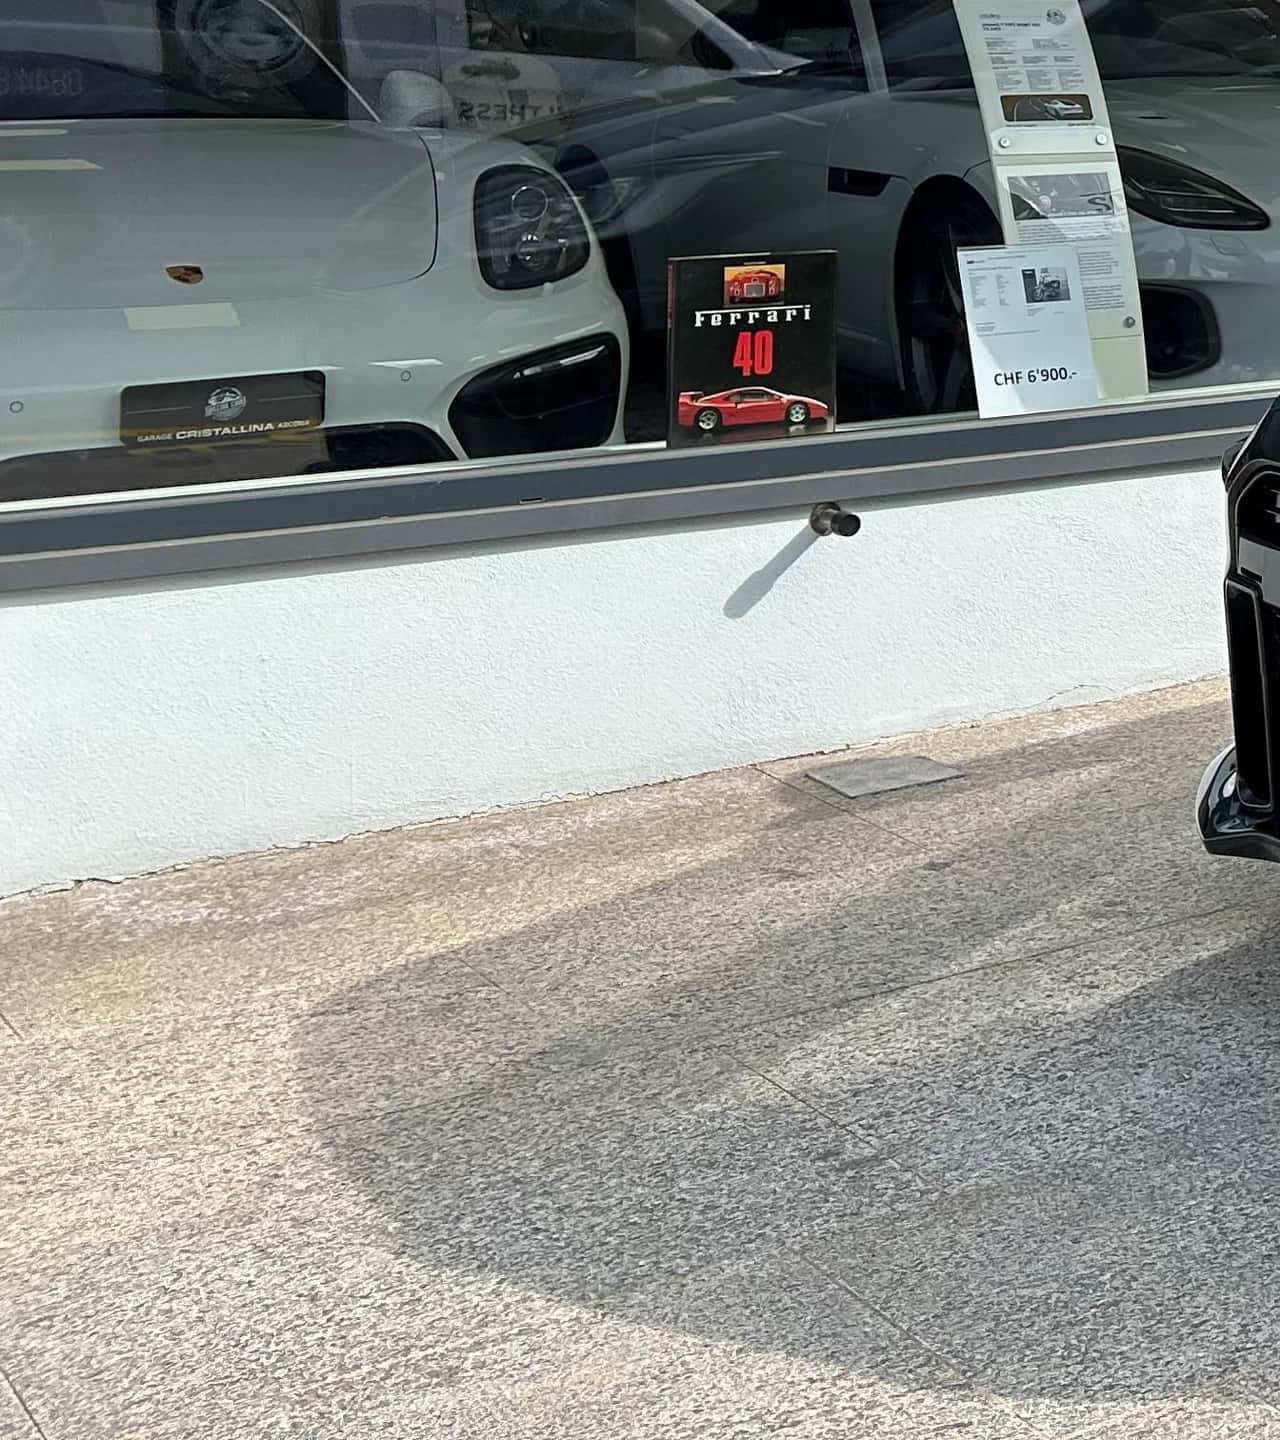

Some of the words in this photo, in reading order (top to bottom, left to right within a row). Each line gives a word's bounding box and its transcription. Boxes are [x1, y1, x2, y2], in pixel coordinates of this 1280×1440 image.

[694, 304, 812, 328] Ferrari
[733, 329, 774, 377] 40
[993, 370, 1023, 387] CHF
[1026, 366, 1078, 384] 6'900.-
[175, 422, 275, 440] CRISTALLINA
